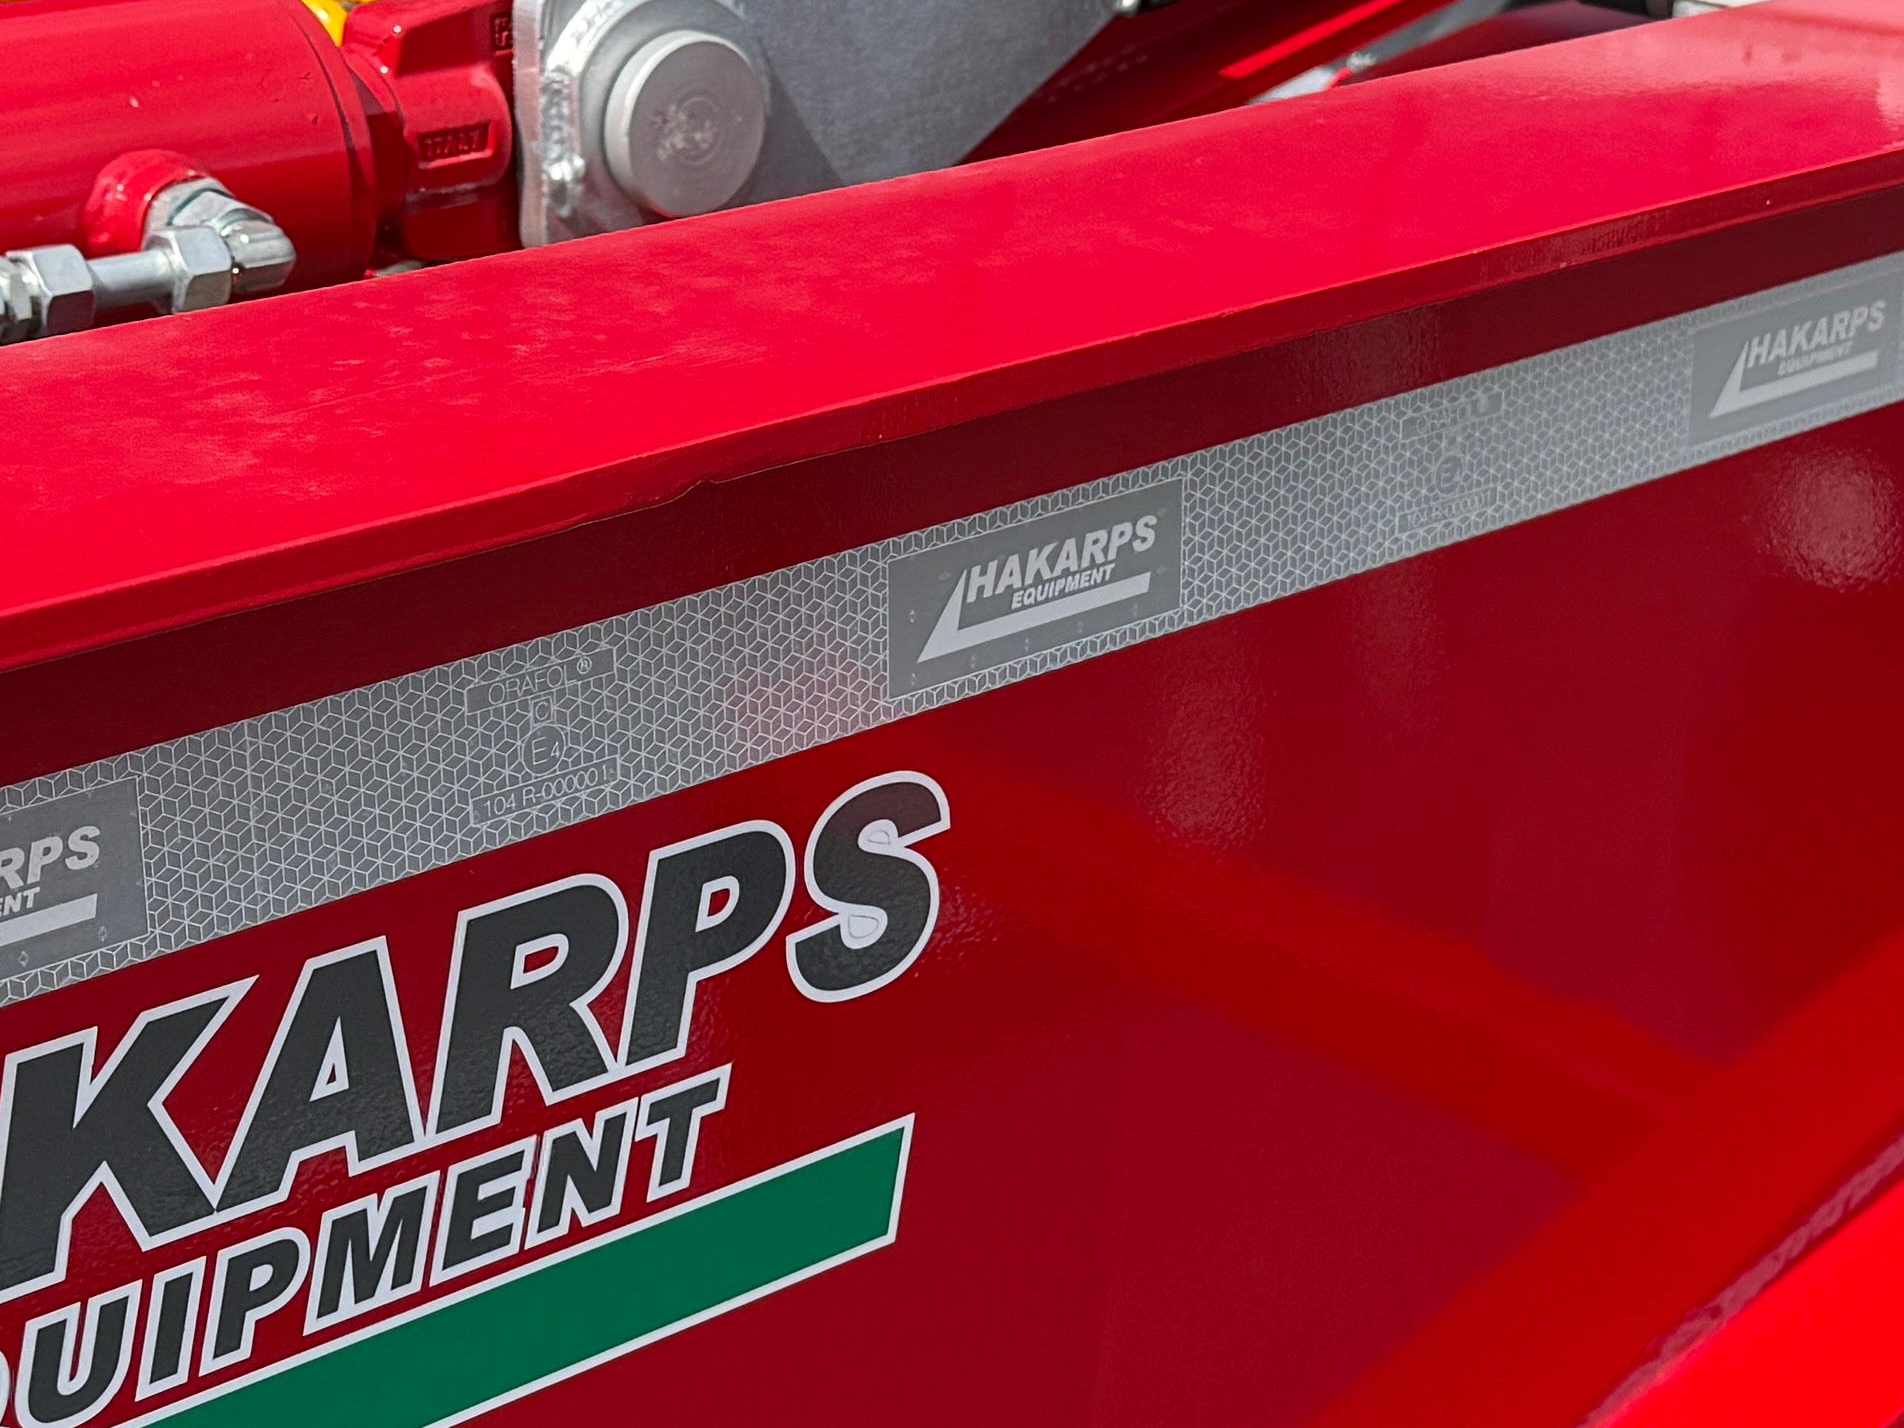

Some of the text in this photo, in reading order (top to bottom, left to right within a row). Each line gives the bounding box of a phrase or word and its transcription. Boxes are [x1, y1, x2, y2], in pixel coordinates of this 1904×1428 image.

[1745, 299, 1886, 368] HAKARPS
[966, 514, 1158, 605] HAKARPS
[1011, 563, 1117, 611] EQUIPMENT
[484, 763, 607, 817] 104 R-000001
